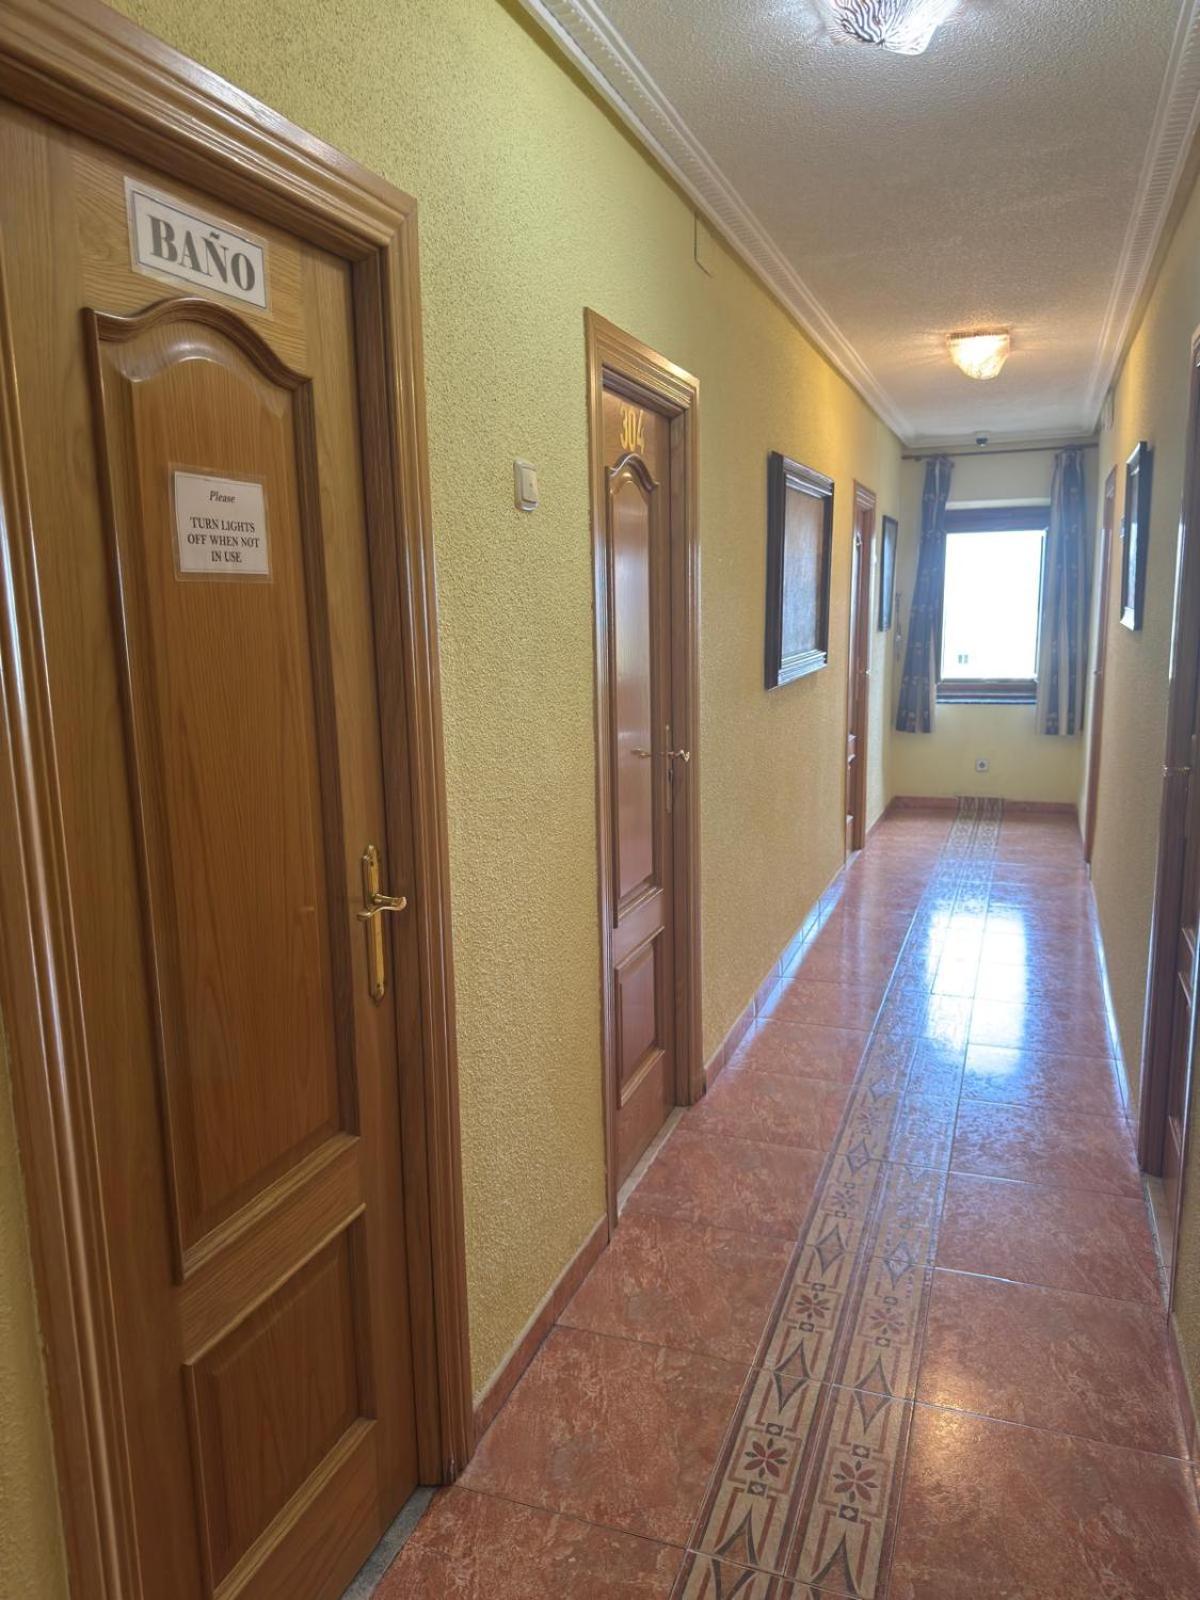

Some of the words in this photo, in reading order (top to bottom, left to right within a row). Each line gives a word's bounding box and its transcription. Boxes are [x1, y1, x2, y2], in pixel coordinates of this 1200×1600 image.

[147, 214, 256, 292] BAÑO
[209, 490, 236, 503] Please
[190, 516, 219, 530] TURN
[221, 519, 256, 533] LIGHTS
[187, 533, 207, 545] OFF
[209, 534, 239, 547] WHEN
[240, 537, 260, 548] NOT
[211, 550, 222, 562] IN
[224, 551, 242, 563] USE
